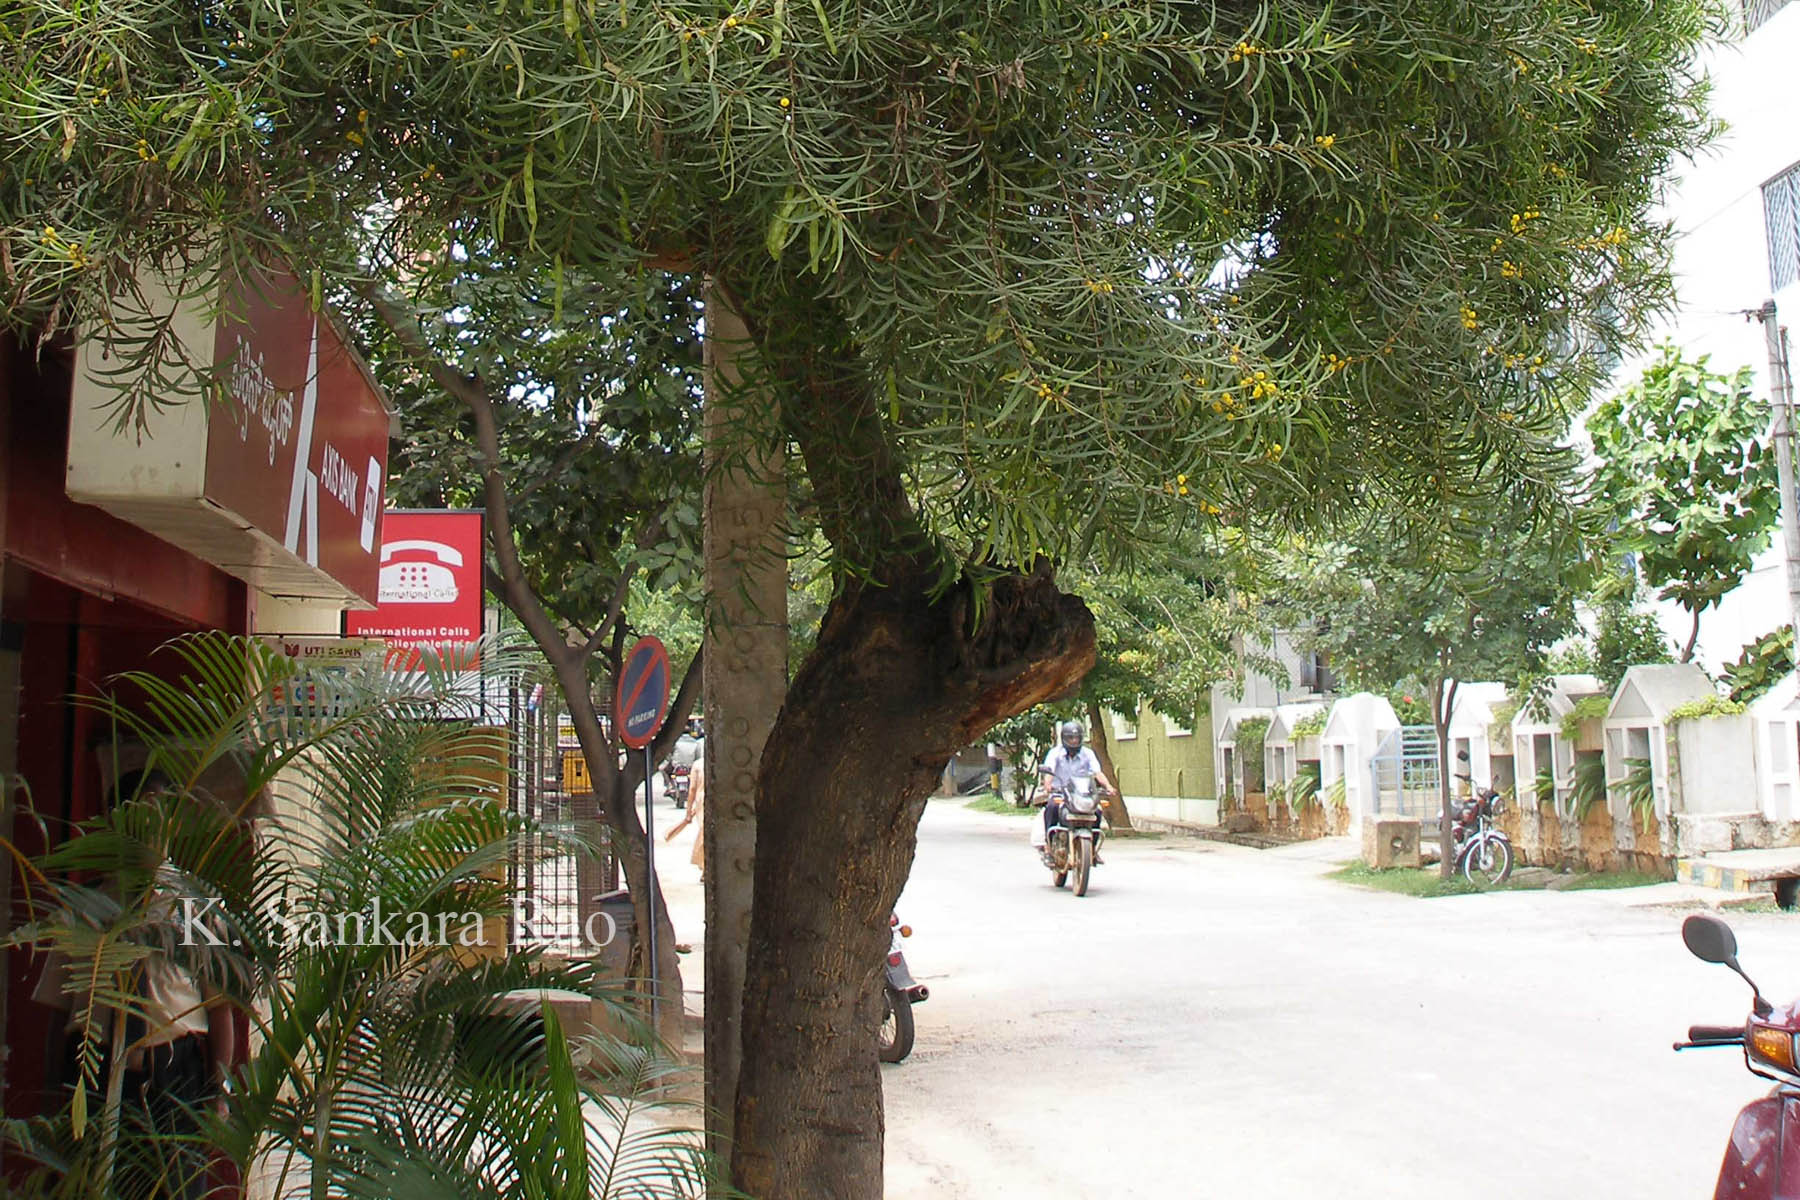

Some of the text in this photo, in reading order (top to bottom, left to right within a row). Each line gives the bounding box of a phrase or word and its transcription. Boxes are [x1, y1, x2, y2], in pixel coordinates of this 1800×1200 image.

[321, 440, 358, 516] AXIS BANK
[358, 627, 470, 636] International Calls
[305, 647, 324, 657] UTI
